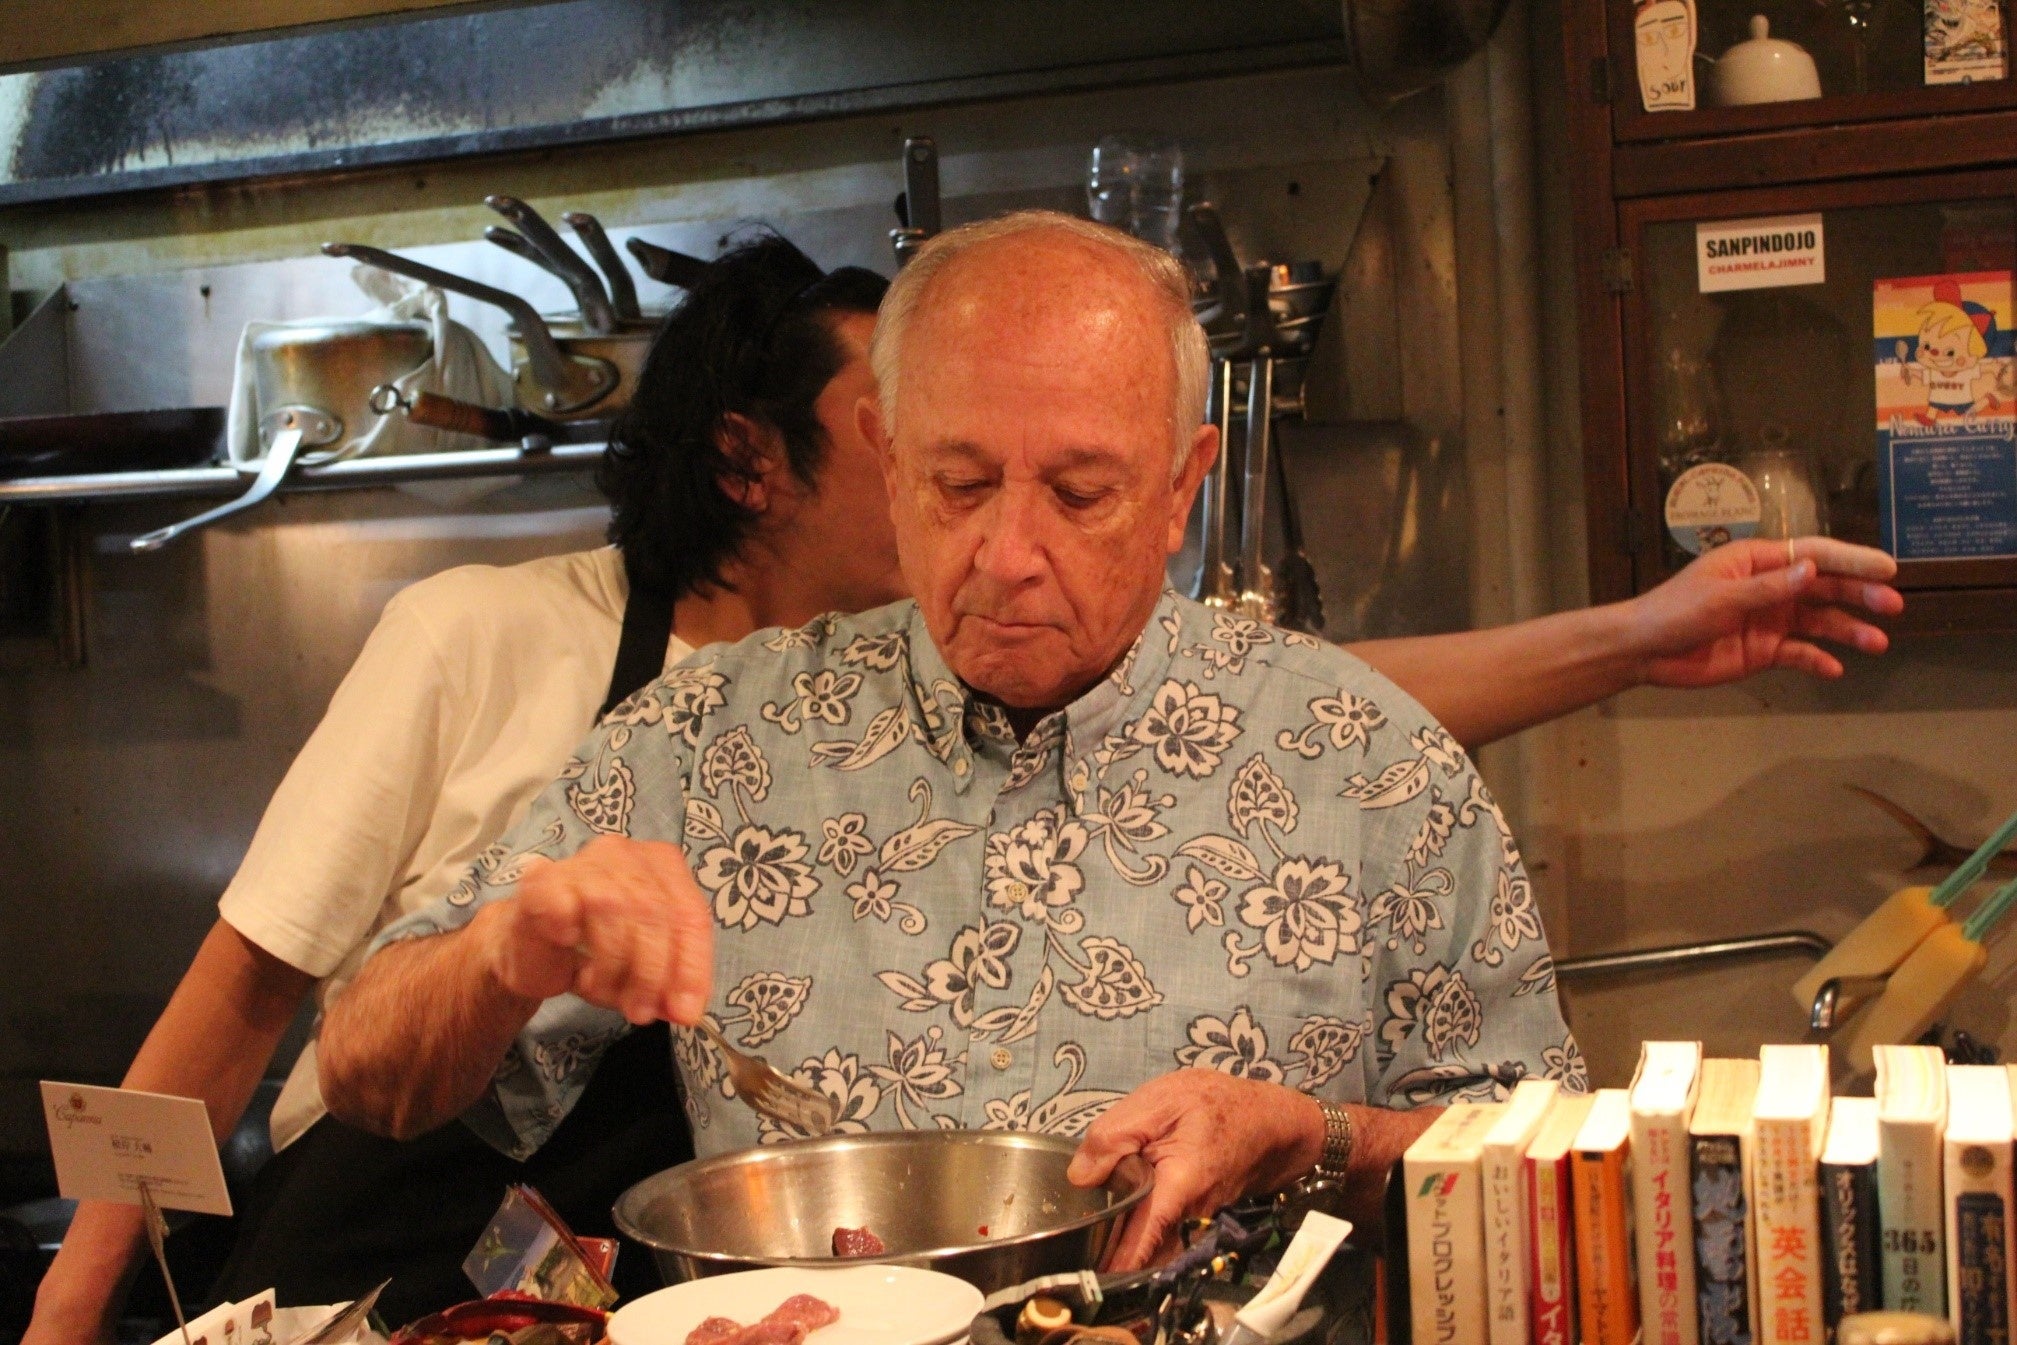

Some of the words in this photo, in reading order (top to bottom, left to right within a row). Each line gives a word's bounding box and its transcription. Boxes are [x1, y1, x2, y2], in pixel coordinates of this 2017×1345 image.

[1706, 230, 1816, 259] SANPINDOJO
[1771, 1227, 1810, 1342] 英会話
